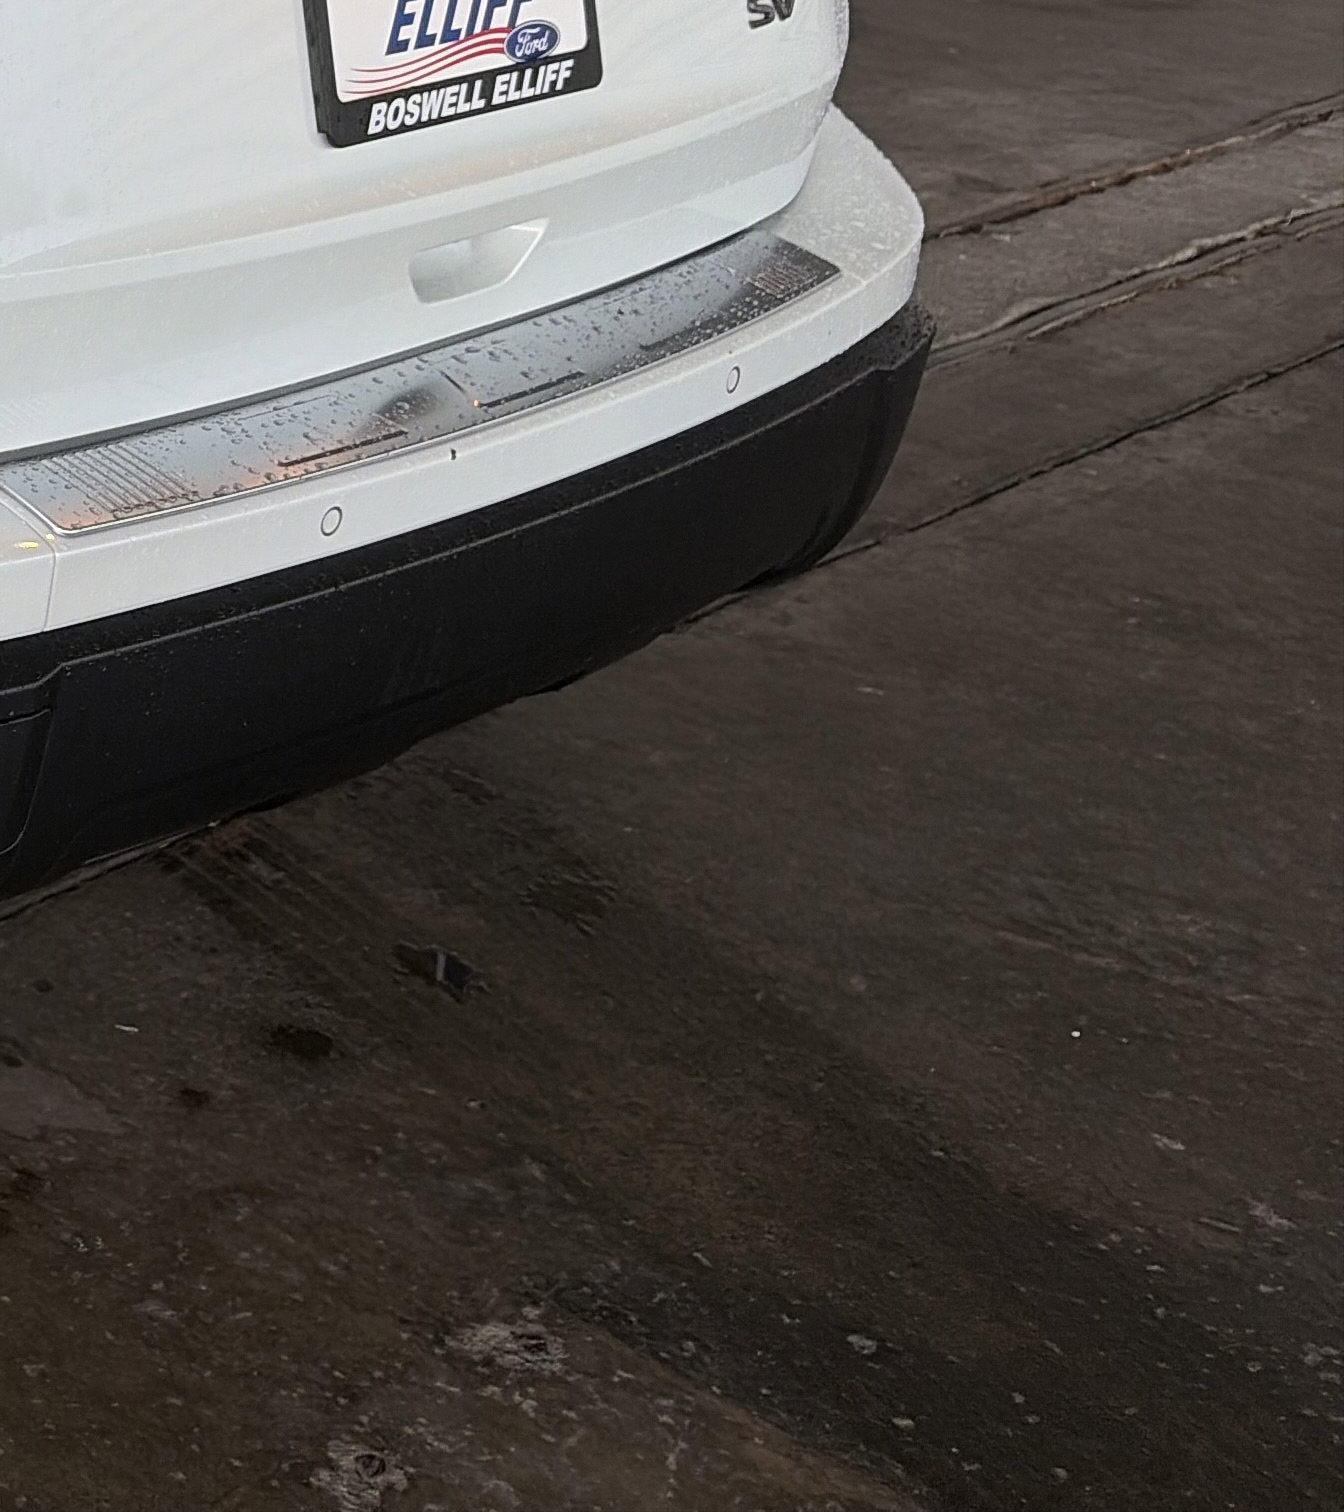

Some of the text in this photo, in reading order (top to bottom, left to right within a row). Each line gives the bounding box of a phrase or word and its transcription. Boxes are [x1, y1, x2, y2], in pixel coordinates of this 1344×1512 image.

[515, 28, 550, 56] Ford
[367, 59, 575, 135] BOSWELL ELLIFF
